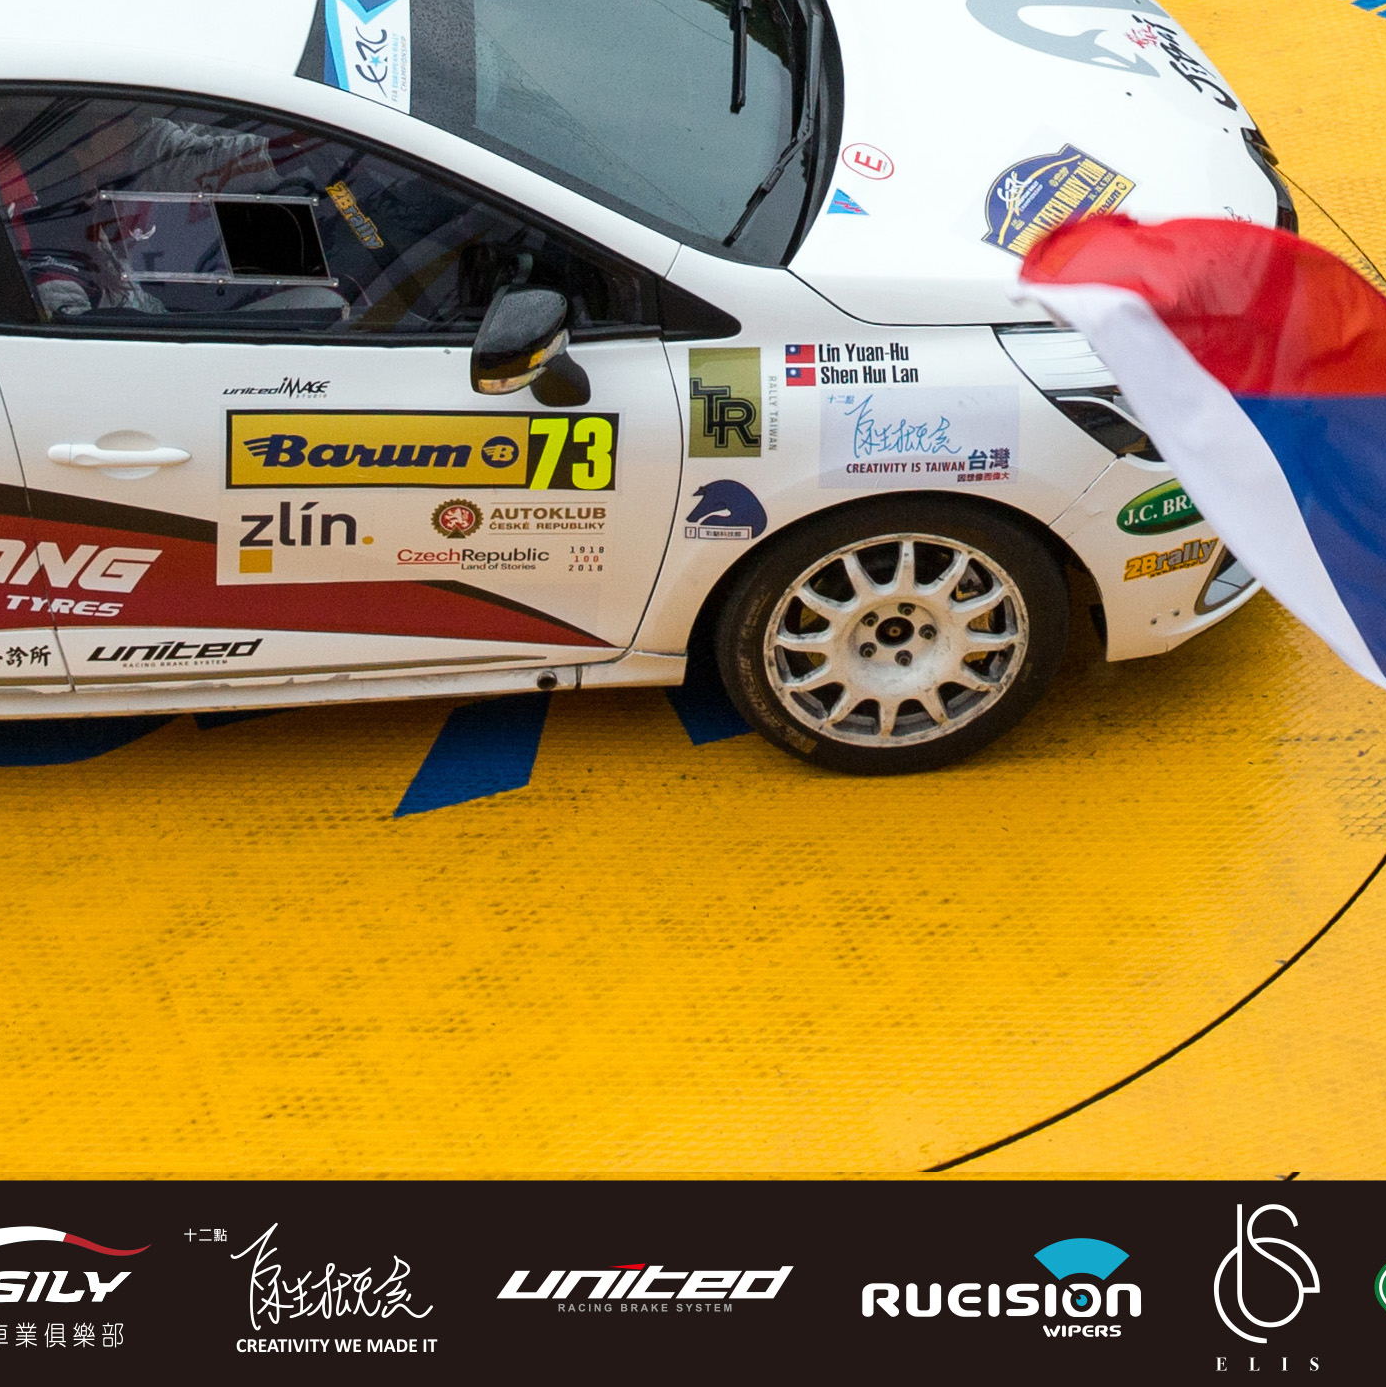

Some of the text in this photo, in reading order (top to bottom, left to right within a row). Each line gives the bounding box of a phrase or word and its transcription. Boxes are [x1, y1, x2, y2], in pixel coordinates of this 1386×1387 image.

[818, 343, 910, 362] Lin Yuan-Hu
[821, 366, 858, 385] Shen
[892, 366, 919, 384] Lan
[768, 375, 778, 452] RALLY TAIWAN
[243, 417, 613, 491] Barum 73
[967, 448, 1010, 471] 台灣
[846, 460, 965, 474] CREATIVITY IS TAIWAN
[490, 507, 607, 520] AUTOKLUB
[1124, 505, 1157, 526] J.C.
[489, 521, 605, 531] ČESKÉ REPUBLIKY
[397, 548, 550, 565] CzechRepublic
[1123, 537, 1220, 582] 2Brally
[461, 563, 536, 571] Land of Stories
[6, 594, 125, 618] TYRES
[87, 638, 264, 661] united
